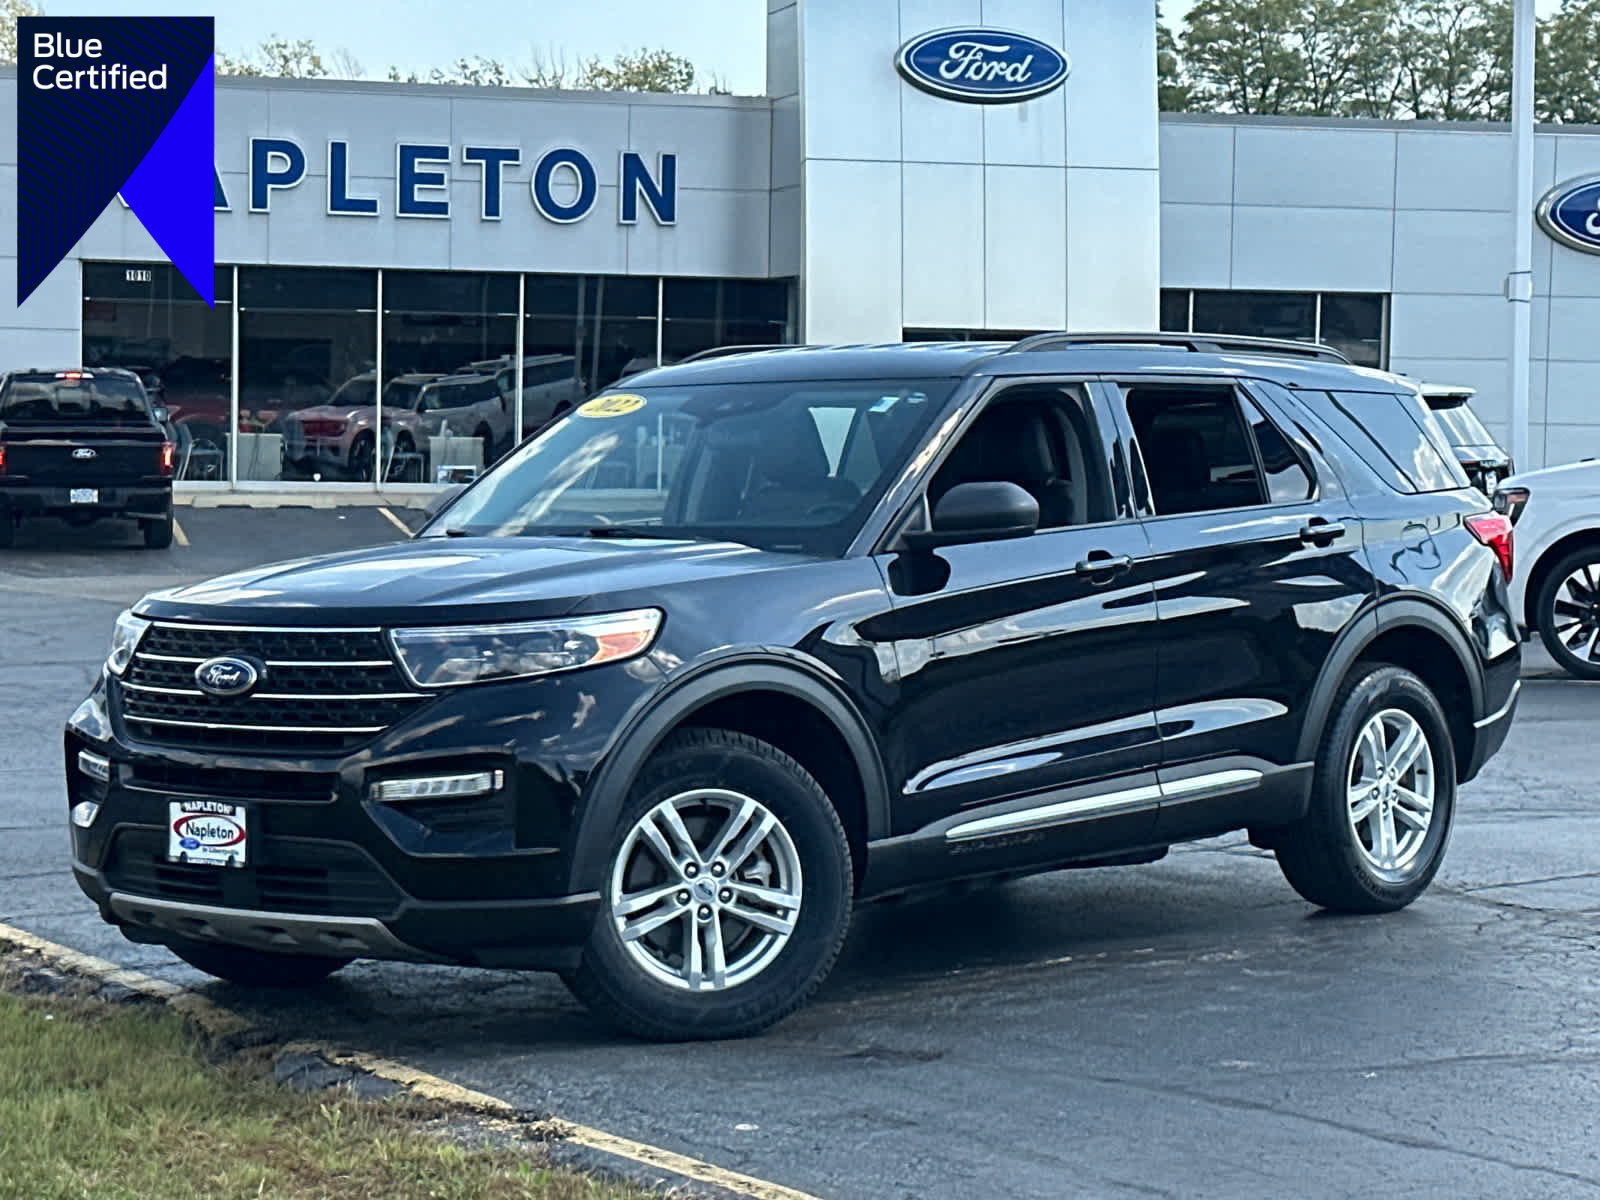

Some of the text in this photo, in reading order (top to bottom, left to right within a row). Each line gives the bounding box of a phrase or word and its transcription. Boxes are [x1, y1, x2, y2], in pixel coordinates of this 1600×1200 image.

[939, 41, 1034, 83] Ford
[213, 137, 678, 226] PLETON
[206, 665, 241, 685] Ford
[186, 821, 234, 841] Napleton
